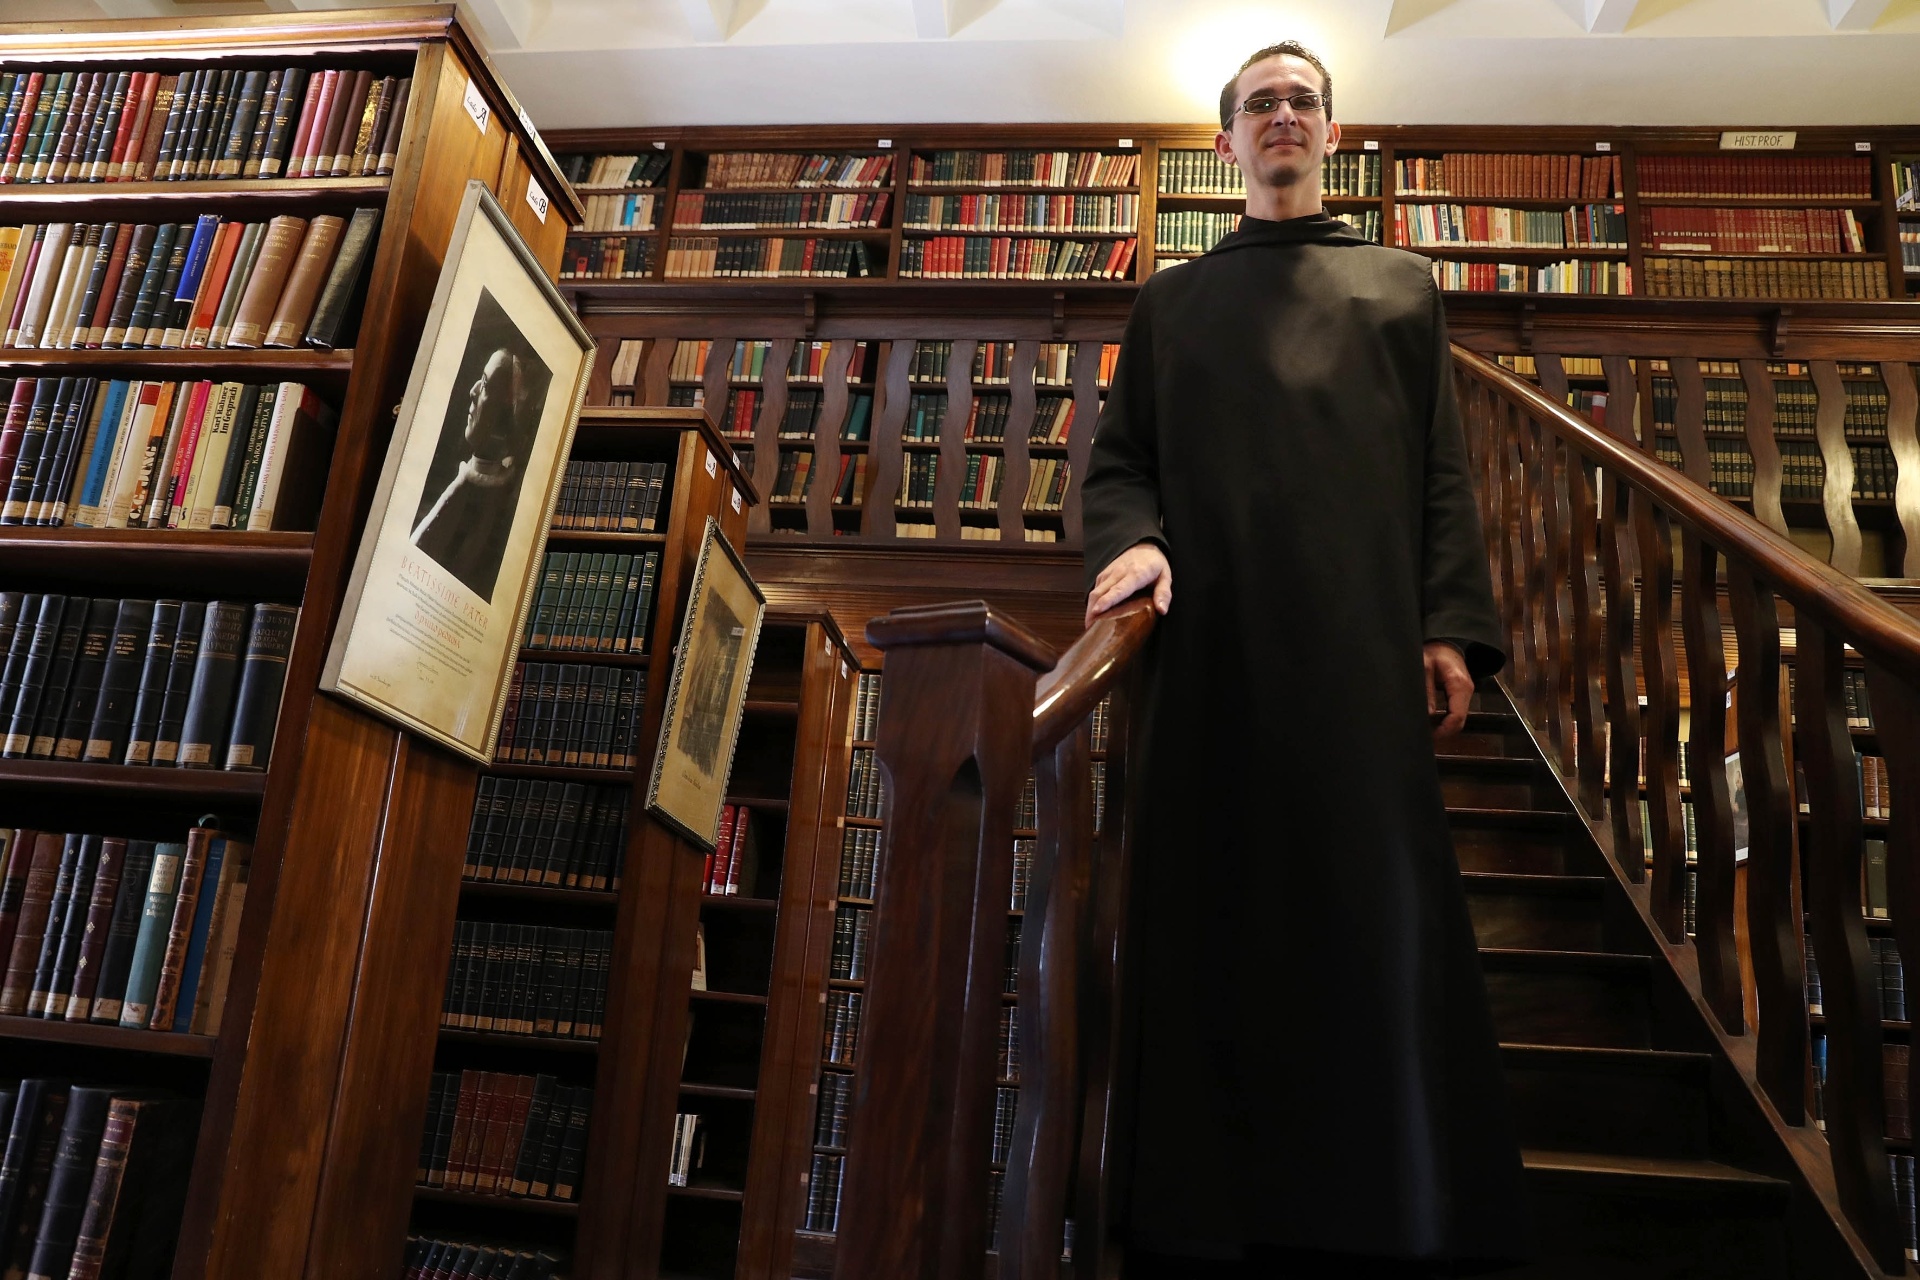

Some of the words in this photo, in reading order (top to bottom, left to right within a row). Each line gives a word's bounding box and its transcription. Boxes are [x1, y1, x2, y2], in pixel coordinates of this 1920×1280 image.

[476, 106, 487, 126] A
[538, 198, 547, 214] B
[212, 415, 222, 434] Karl
[220, 386, 229, 412] Rahner
[225, 386, 238, 422] Gespräch
[252, 439, 264, 464] KAROL
[258, 407, 270, 440] WOJTYLA
[140, 445, 157, 490] JUNG
[401, 556, 461, 608] BEATISSIME
[463, 603, 489, 630] PATER
